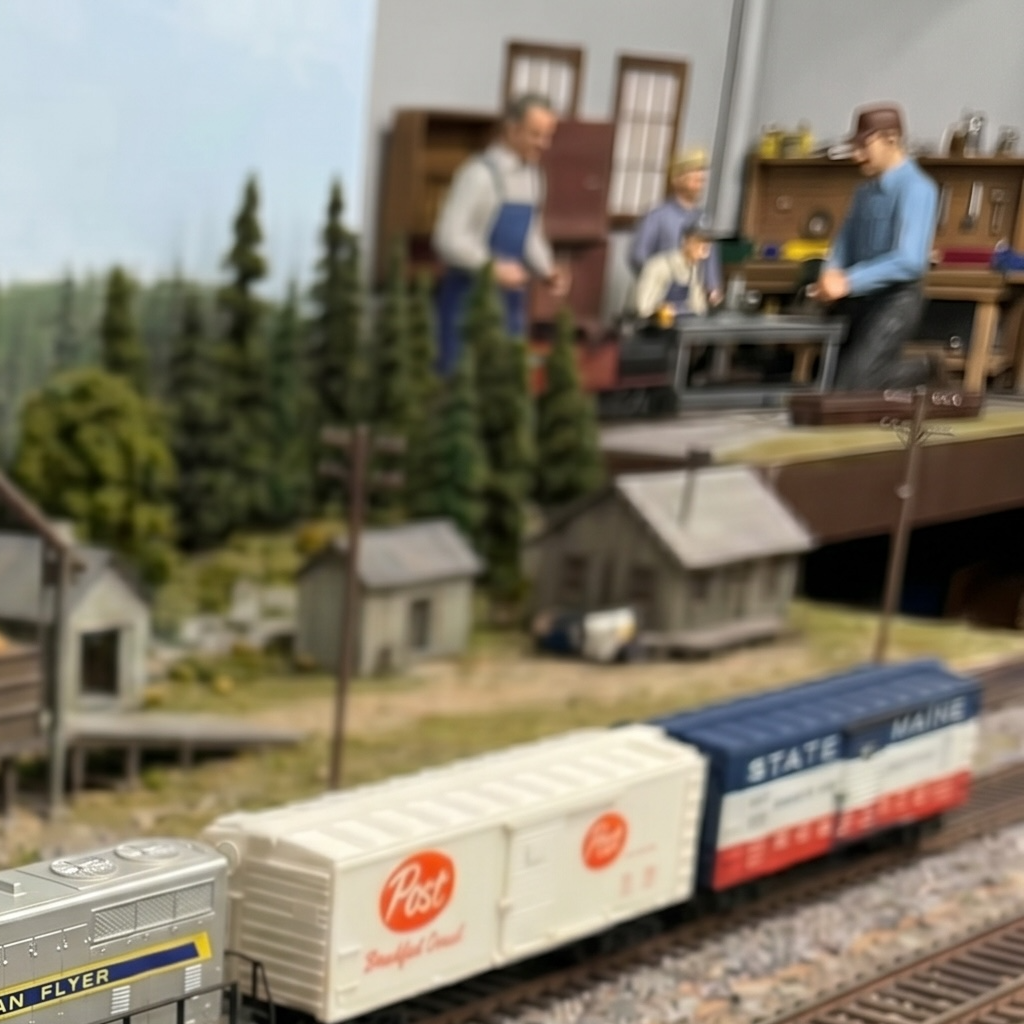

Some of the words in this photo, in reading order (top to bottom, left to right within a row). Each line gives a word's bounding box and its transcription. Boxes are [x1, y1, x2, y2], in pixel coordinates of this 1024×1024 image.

[747, 731, 841, 784] STATE
[890, 696, 966, 741] MAINE
[385, 861, 449, 922] Post
[40, 968, 109, 1000] FLYER
